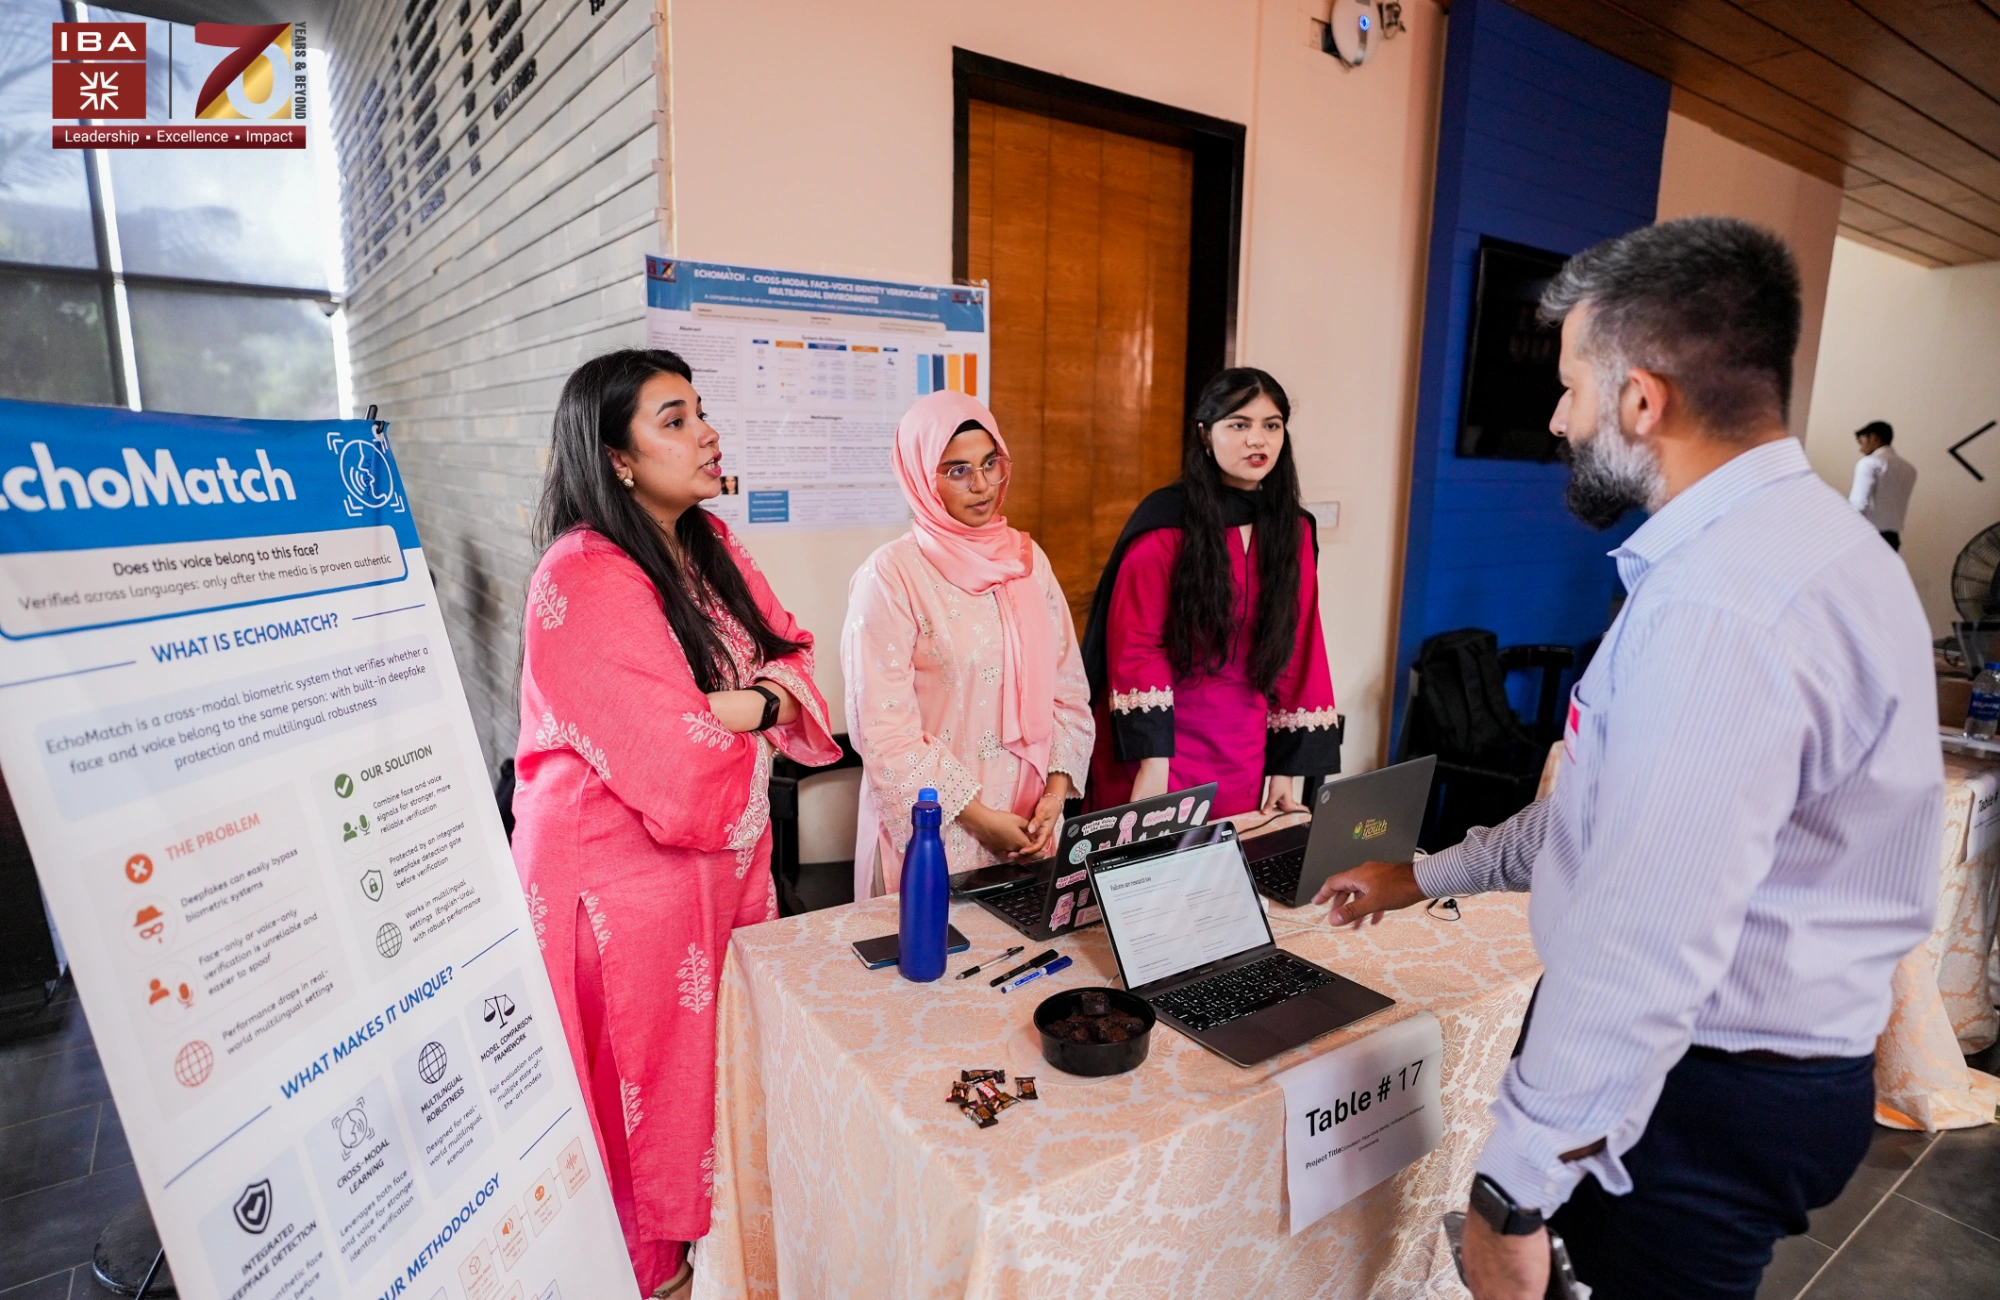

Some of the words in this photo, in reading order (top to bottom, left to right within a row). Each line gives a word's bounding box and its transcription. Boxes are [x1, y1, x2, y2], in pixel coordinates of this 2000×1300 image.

[694, 269, 745, 282] ECHOMATCH
[753, 274, 809, 288] CROSS-MODAL
[810, 279, 854, 291] FACE-VOICE
[855, 284, 884, 294] IDENTITY
[886, 287, 930, 299] VERIFICATION
[930, 291, 938, 300] IN
[768, 286, 822, 300] MULTILINGUAL
[822, 291, 879, 304] ENVIRONMENTS
[0, 441, 297, 512] choMatch
[112, 562, 149, 576] Does
[151, 557, 177, 572] this
[179, 554, 212, 568] voice
[213, 551, 255, 565] belong
[256, 550, 269, 561] to
[270, 546, 291, 559] this
[292, 542, 318, 556] face?
[18, 590, 81, 610] Verified
[83, 589, 127, 603] across
[128, 580, 199, 598] languages:
[202, 574, 227, 589] only
[229, 572, 255, 584] after
[257, 569, 275, 581] the
[277, 564, 308, 578] media
[319, 561, 352, 575] proven
[353, 554, 391, 568] authentic
[150, 636, 208, 662] WHAT
[212, 632, 230, 651] IS
[233, 612, 338, 647] ECHOMATCH?
[44, 721, 133, 754] EchoMatch
[163, 692, 241, 724] cross-modal
[241, 680, 294, 703] biometric
[295, 672, 330, 691] system
[331, 665, 353, 679] that
[353, 657, 385, 673] verifies
[386, 650, 418, 664] whether
[68, 756, 104, 774] face
[107, 743, 138, 763] and
[140, 736, 176, 754] voice
[177, 723, 221, 743] belong
[221, 719, 235, 730] to
[237, 713, 257, 726] the
[259, 704, 288, 720] same
[290, 692, 328, 713] person:
[329, 684, 351, 699] with
[352, 675, 386, 693] built-in
[387, 664, 425, 682] deepfake
[173, 741, 235, 771] protection
[237, 730, 260, 747] and
[262, 710, 326, 740] multilingual
[327, 697, 377, 720] robustness
[360, 764, 383, 781] OUR
[384, 744, 432, 772] SOLUTION
[372, 793, 400, 809] Combine
[400, 787, 413, 796] face
[414, 780, 426, 791] and
[426, 774, 442, 785] voice
[376, 807, 398, 822] signals
[409, 790, 435, 806] stronger,
[436, 783, 451, 794] more
[1978, 795, 1994, 814] Table
[164, 838, 195, 861] THE
[195, 812, 260, 849] PROBLEM
[380, 818, 404, 834] reliable
[404, 802, 437, 822] verification
[388, 844, 418, 864] Protected
[435, 821, 464, 840] integrated
[392, 858, 420, 877] deepfake
[421, 843, 448, 861] detection
[448, 836, 461, 849] gate
[180, 880, 228, 908] Deepfakes
[229, 872, 244, 884] can
[246, 861, 269, 876] easily
[270, 848, 298, 865] bypass
[395, 874, 416, 889] before
[416, 856, 448, 877] verification
[184, 897, 228, 923] biometric
[229, 880, 263, 902] systems
[404, 904, 424, 918] Works
[431, 878, 466, 903] multilingual
[412, 930, 426, 943] with
[426, 918, 446, 934] robust
[446, 896, 480, 923] performance
[197, 937, 243, 965] Face-only
[255, 908, 297, 934] voice-only
[408, 912, 432, 931] settings
[203, 949, 252, 980] verification
[262, 922, 301, 948] unreliable
[302, 911, 318, 925] and
[207, 975, 234, 995] easier
[236, 968, 246, 978] to
[248, 951, 270, 972] spoof
[221, 1002, 276, 1040] Performance
[277, 987, 300, 1005] drops
[309, 970, 328, 985] real-
[226, 1032, 253, 1054] world
[254, 999, 303, 1037] multilingual
[304, 981, 333, 1004] settings
[280, 1052, 328, 1099] WHAT
[332, 1014, 384, 1063] MAKES
[385, 1004, 396, 1024] IT
[398, 965, 452, 1013] UNIQUE?
[480, 1042, 500, 1062] MODEL
[499, 1014, 532, 1045] COMPARISON
[493, 1031, 526, 1063] FRAMEWORK
[488, 1083, 499, 1096] Fair
[500, 1059, 527, 1086] evaluation
[527, 1045, 543, 1061] across
[496, 1080, 518, 1102] multiple
[503, 1088, 523, 1110] the-art
[523, 1072, 542, 1090] models
[420, 1073, 463, 1114] MULTILINGUAL
[425, 1085, 464, 1124] ROBUSTNESS
[1306, 1091, 1372, 1137] Table
[1377, 1074, 1392, 1103] #
[1398, 1060, 1424, 1091] 17
[425, 1124, 453, 1154] Designed
[462, 1104, 477, 1120] real-
[429, 1145, 447, 1166] world
[447, 1113, 482, 1149] multilingual
[336, 1138, 390, 1188] CROSS-MODAL
[446, 1137, 473, 1166] scenarios
[1306, 1154, 1328, 1170] Project
[348, 1157, 384, 1194] LEARNING
[339, 1200, 375, 1237] Leverages
[375, 1184, 392, 1202] both
[392, 1169, 407, 1186] face
[340, 1234, 356, 1254] and
[356, 1217, 374, 1237] voice
[386, 1178, 413, 1208] stronger
[241, 1222, 294, 1275] INTEGRATED
[348, 1232, 376, 1262] identity
[377, 1195, 414, 1233] verification
[378, 1276, 407, 1300] UR
[406, 1171, 499, 1282] METHODOLOGY
[228, 1263, 270, 1300] EEPFAKE
[306, 1250, 324, 1270] face
[294, 1271, 321, 1300] before
